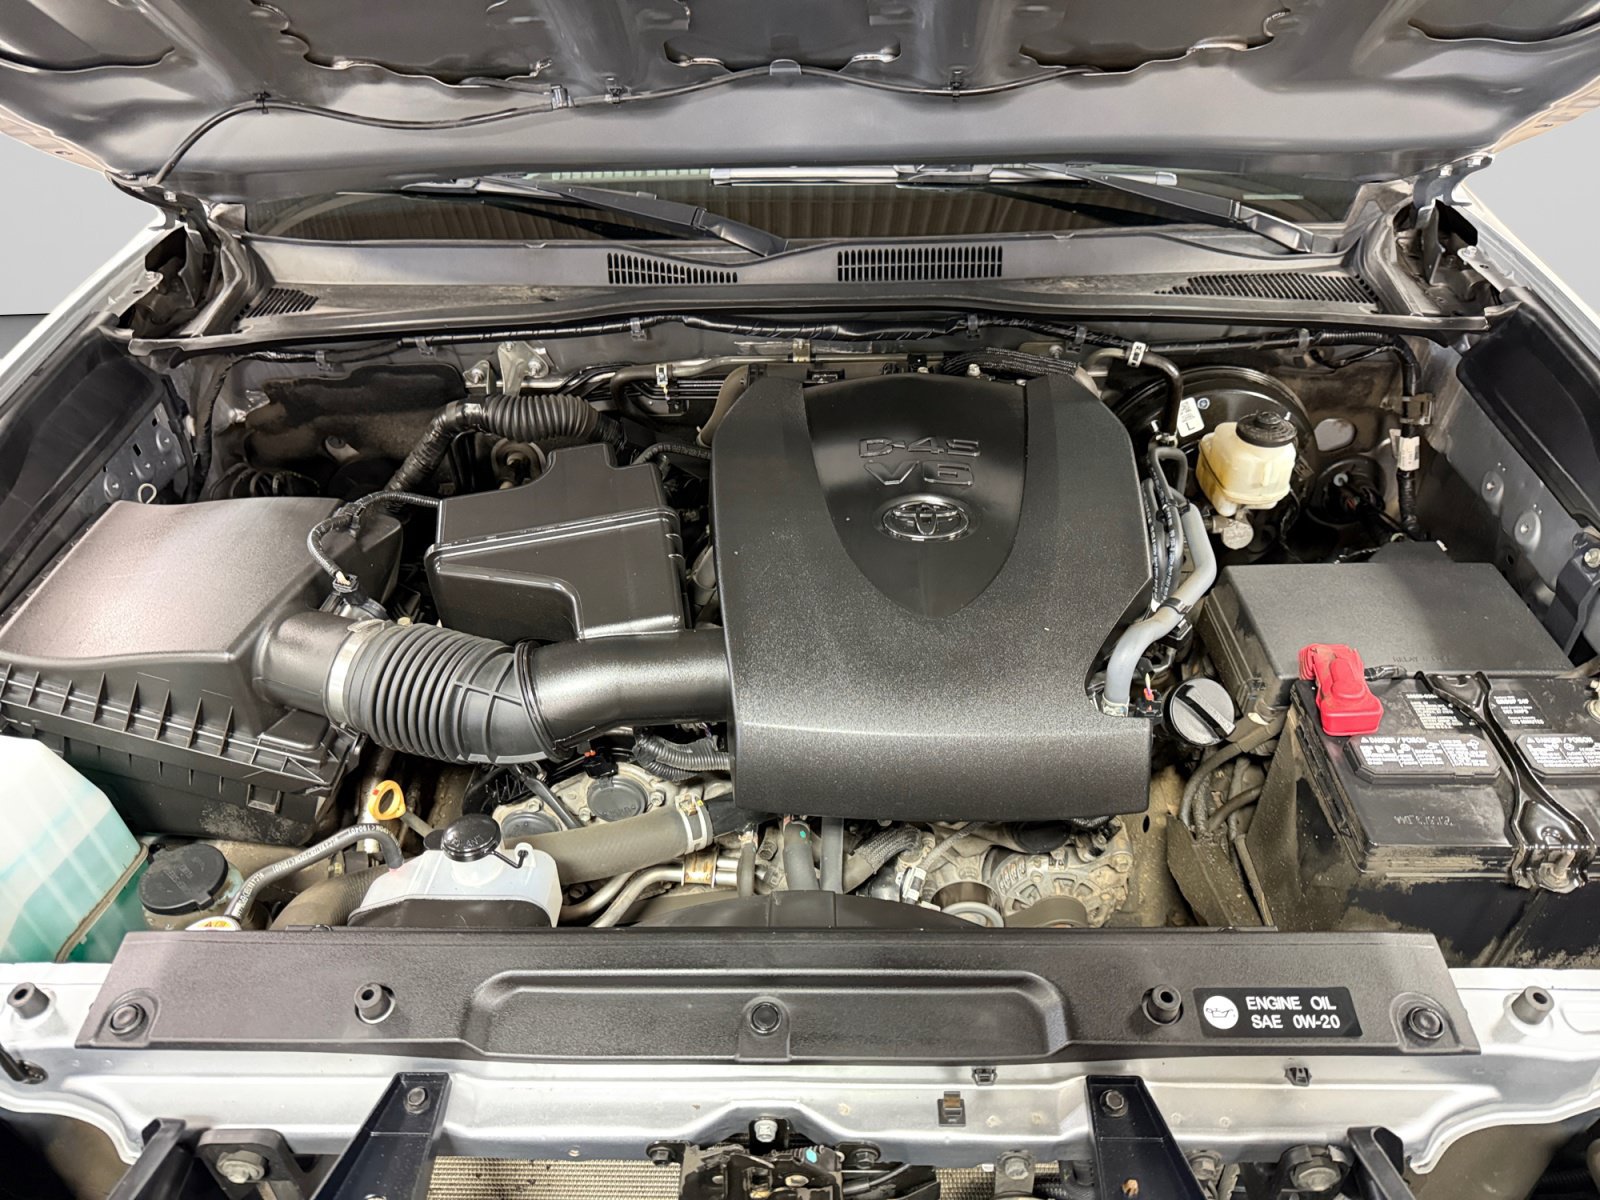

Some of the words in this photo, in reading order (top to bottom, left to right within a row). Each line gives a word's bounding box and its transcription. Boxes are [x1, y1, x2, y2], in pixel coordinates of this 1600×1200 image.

[858, 436, 981, 458] D-4S
[863, 460, 975, 486] V6
[1245, 995, 1302, 1011] ENGINE
[1310, 995, 1337, 1011] OIL
[1251, 1015, 1283, 1030] SAE
[1293, 1014, 1340, 1030] 0W-20
